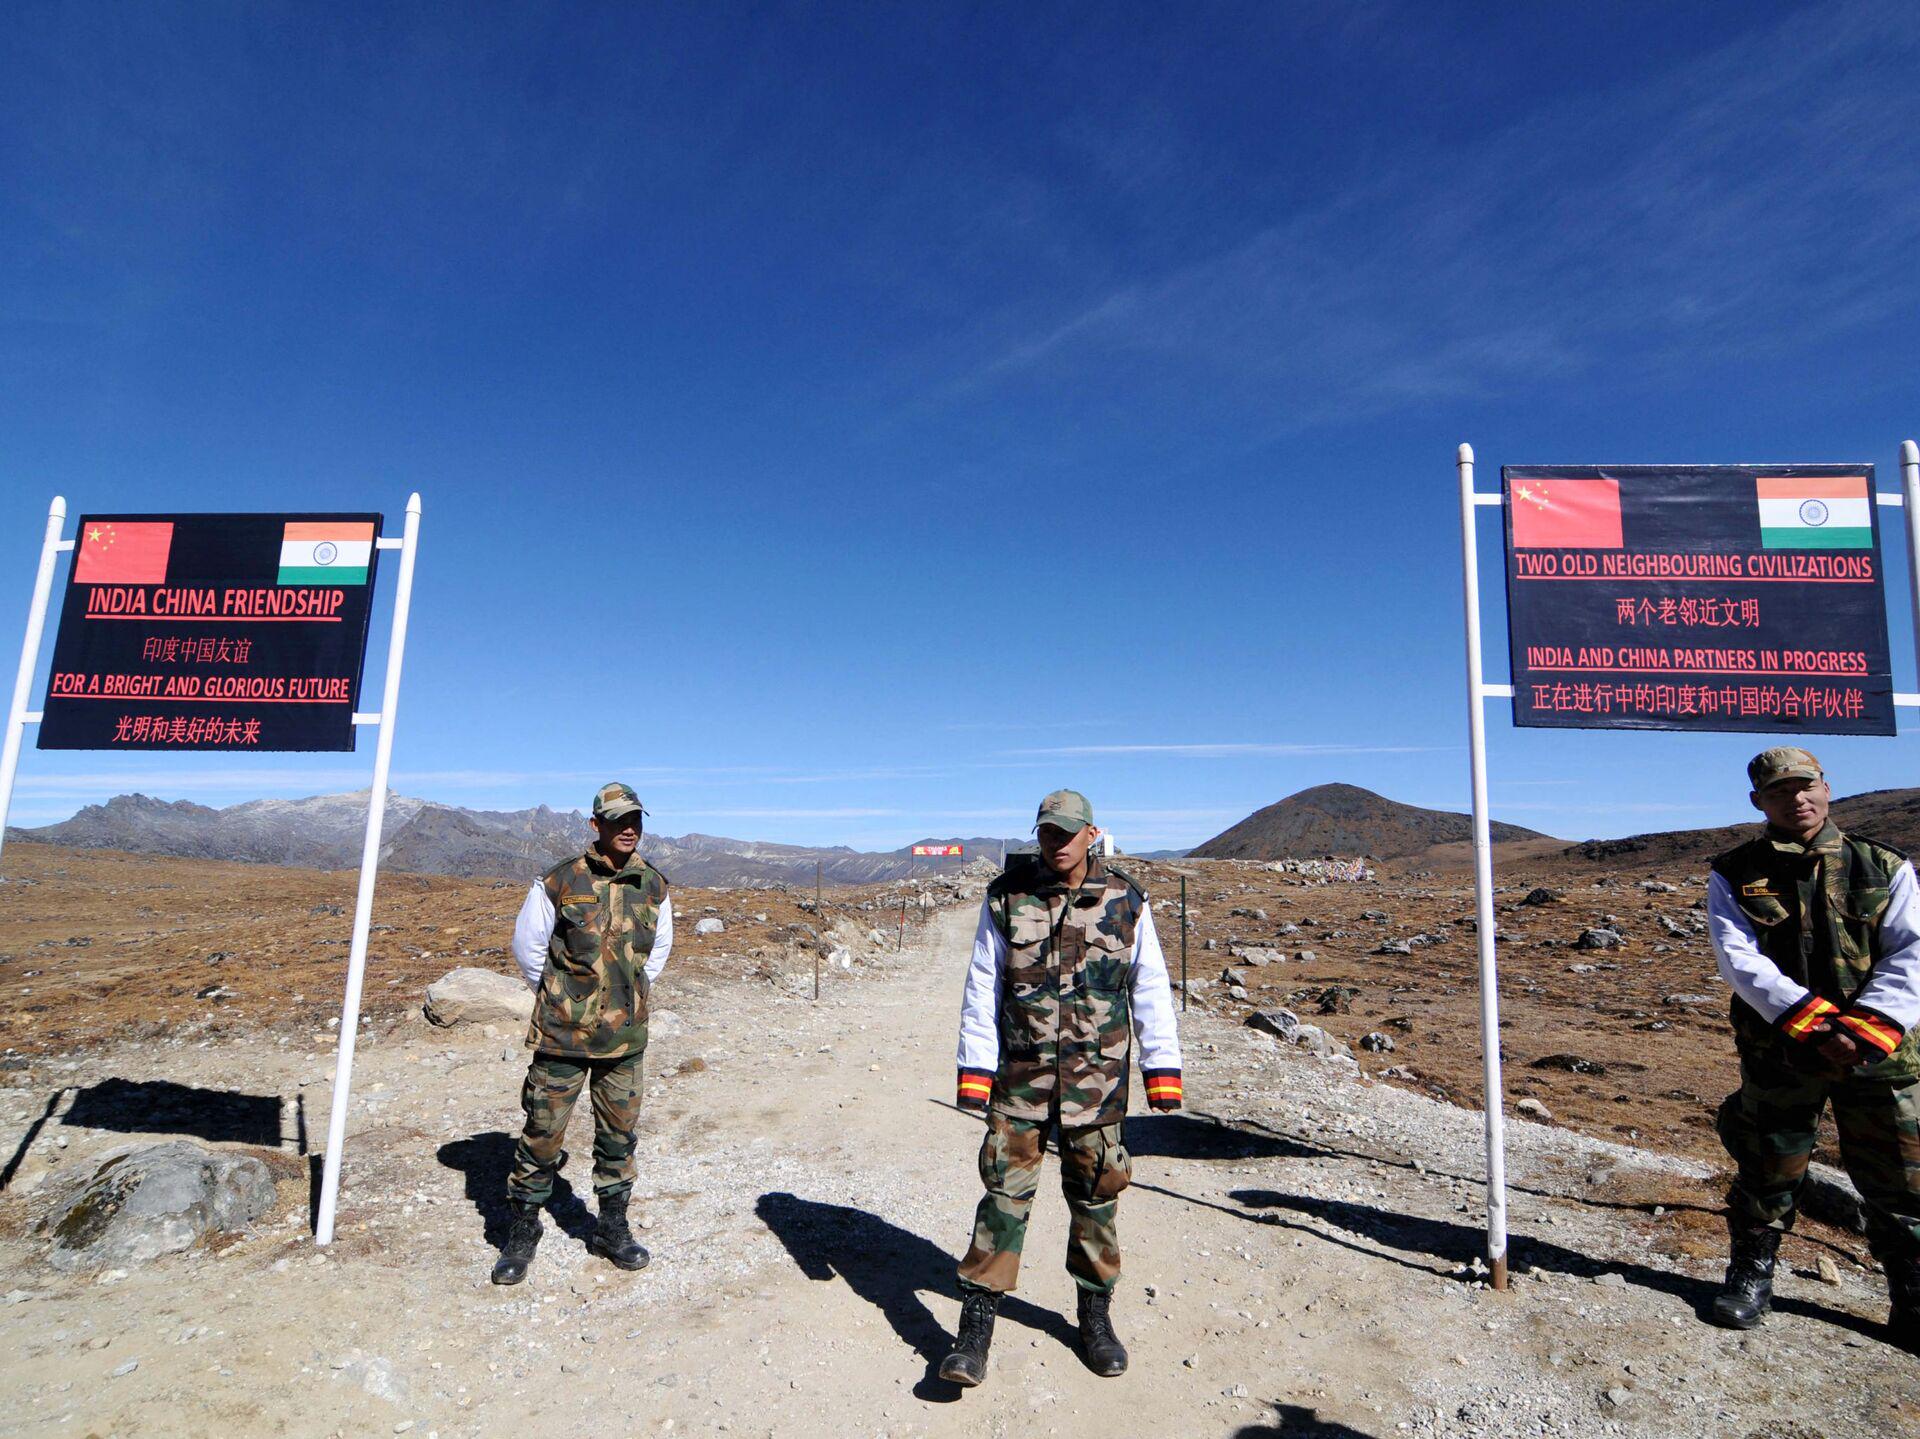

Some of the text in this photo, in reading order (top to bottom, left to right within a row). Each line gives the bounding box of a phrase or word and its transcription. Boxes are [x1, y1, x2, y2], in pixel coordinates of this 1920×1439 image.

[1516, 553, 1873, 578] TWO OLD NEIGHBOURING CIVILIZATIONS
[88, 588, 345, 616] INDIA CHINA FRIENDSHIP
[1616, 597, 1760, 628] 两个老邻近文明
[142, 636, 253, 665] 印度中国友谊
[1528, 647, 1868, 673] INDIA AND CHINA PARTNERS IN PROGRESS
[53, 673, 350, 699] FOR A BRIGHT AND GLORIOUS FUTURE
[1531, 683, 1865, 719] 正在进行中的印度和中国的合作伙伴
[112, 716, 262, 745] 光明和美好的未来
